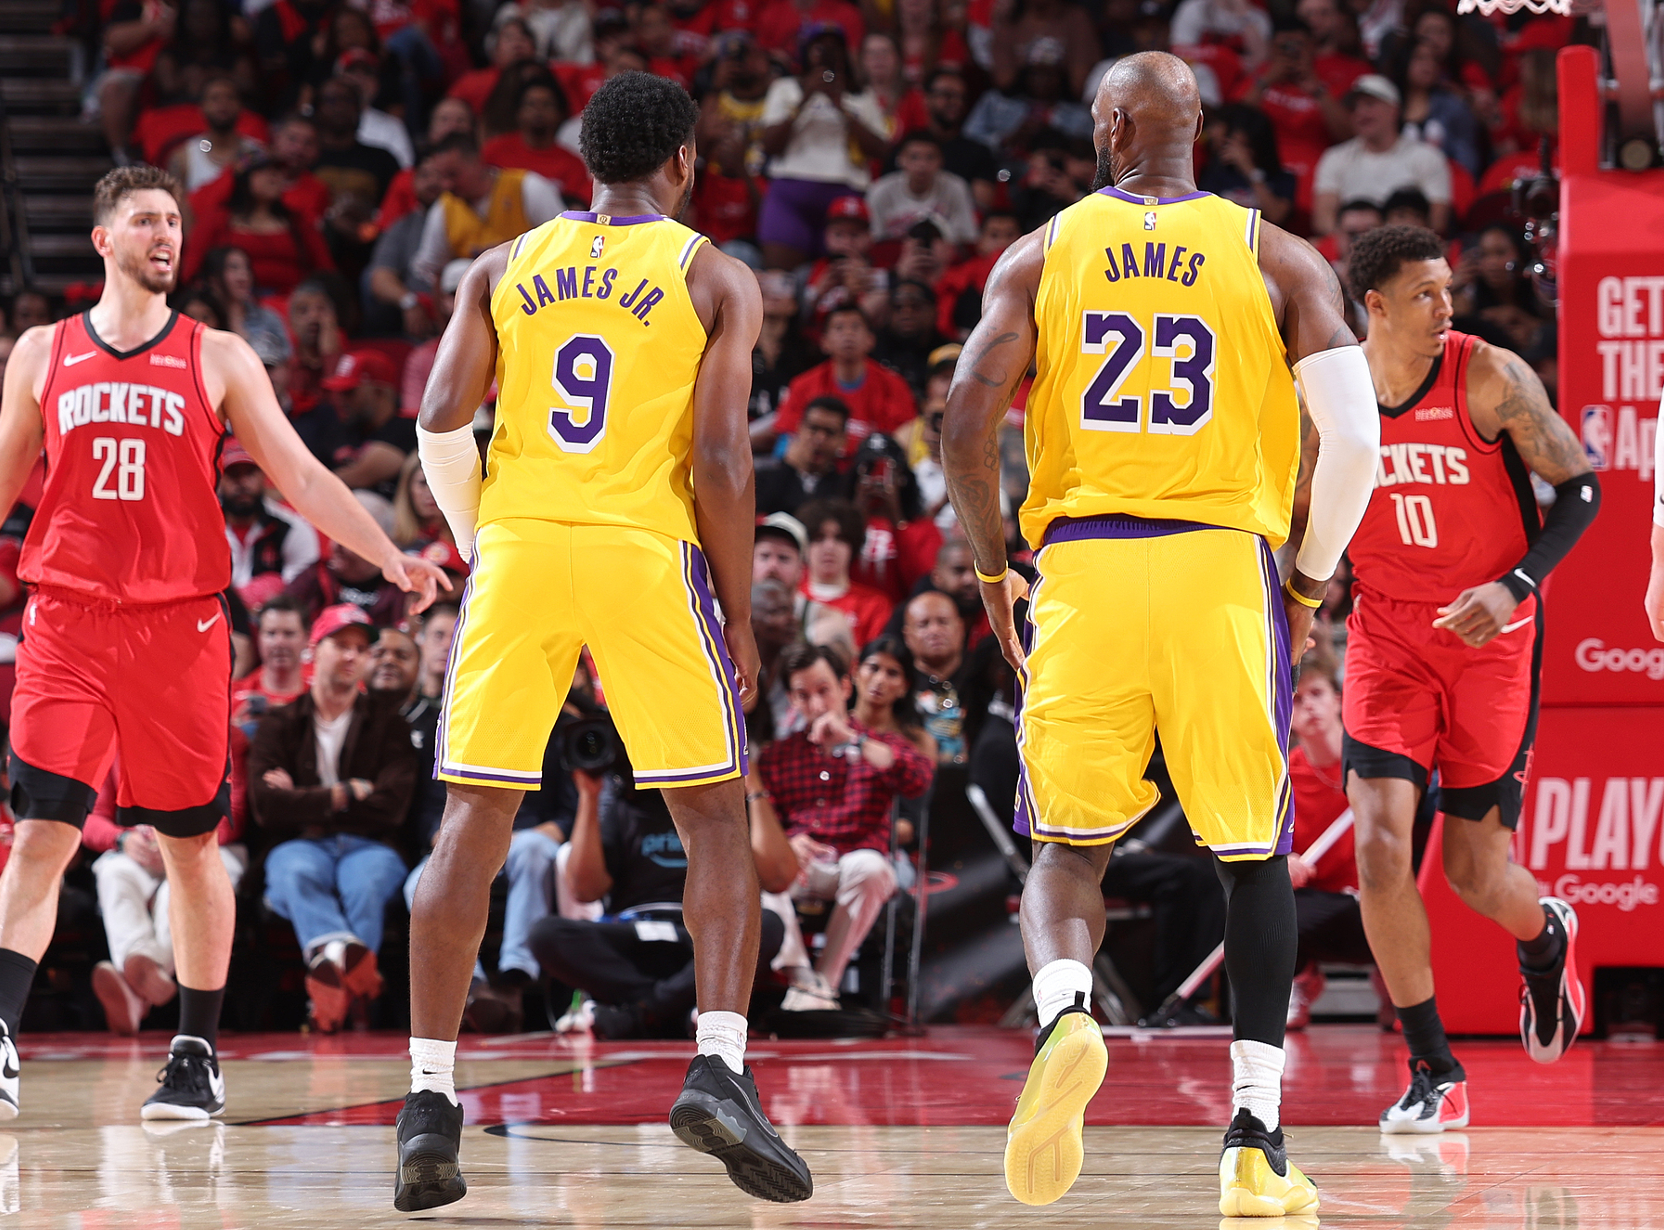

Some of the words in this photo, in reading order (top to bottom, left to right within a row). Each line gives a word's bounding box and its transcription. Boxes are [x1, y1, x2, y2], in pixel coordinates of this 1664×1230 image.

[1105, 241, 1206, 287] JAMES
[515, 266, 618, 316] JAMES
[619, 278, 665, 327] JR.
[1597, 275, 1664, 338] GET
[547, 332, 616, 454] 9
[1080, 310, 1217, 436] 23
[58, 382, 185, 437] ROCKETS
[92, 436, 146, 501] 28
[1374, 442, 1471, 489] CKETS
[1389, 492, 1438, 549] 10
[1529, 776, 1664, 871] PLAY
[1554, 873, 1661, 912] Google
